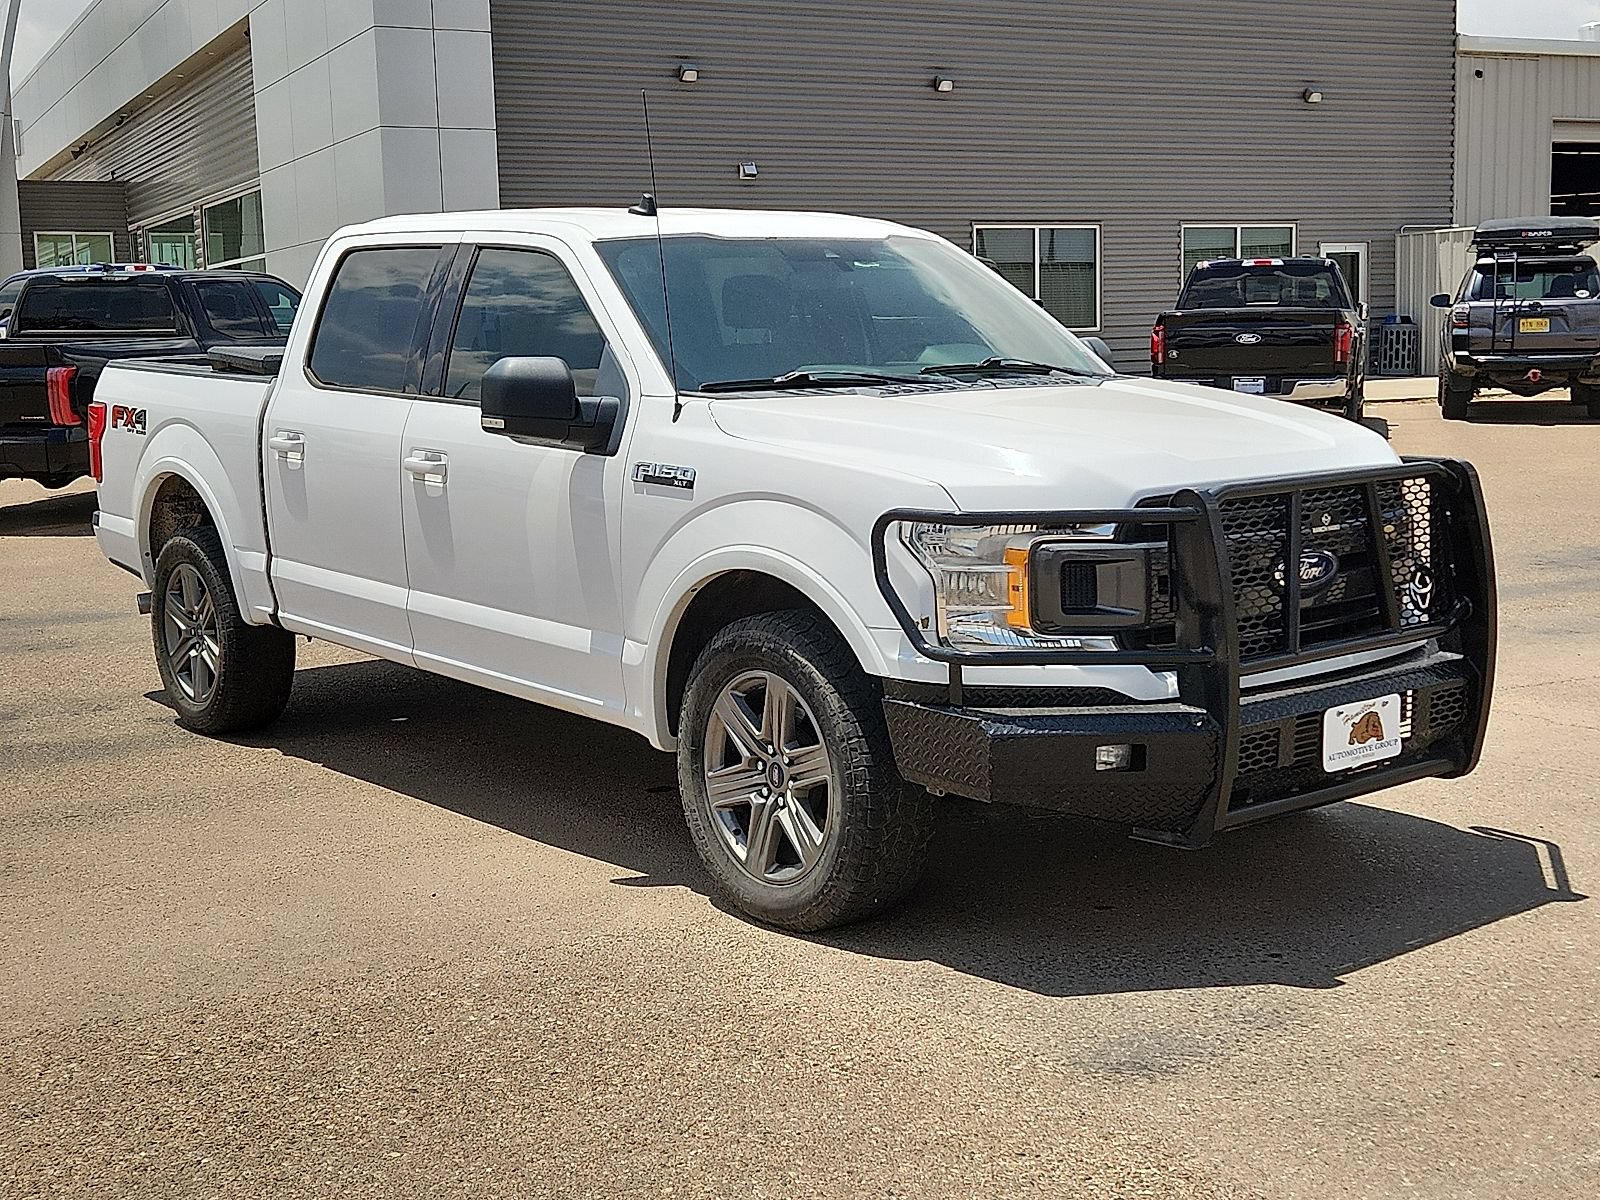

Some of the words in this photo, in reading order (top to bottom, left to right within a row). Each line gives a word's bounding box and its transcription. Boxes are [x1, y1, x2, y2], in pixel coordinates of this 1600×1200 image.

[111, 404, 147, 431] FX4
[672, 479, 688, 487] XLT
[1327, 744, 1374, 762] AUTOMOTIVE
[1374, 738, 1399, 751] GROUP
